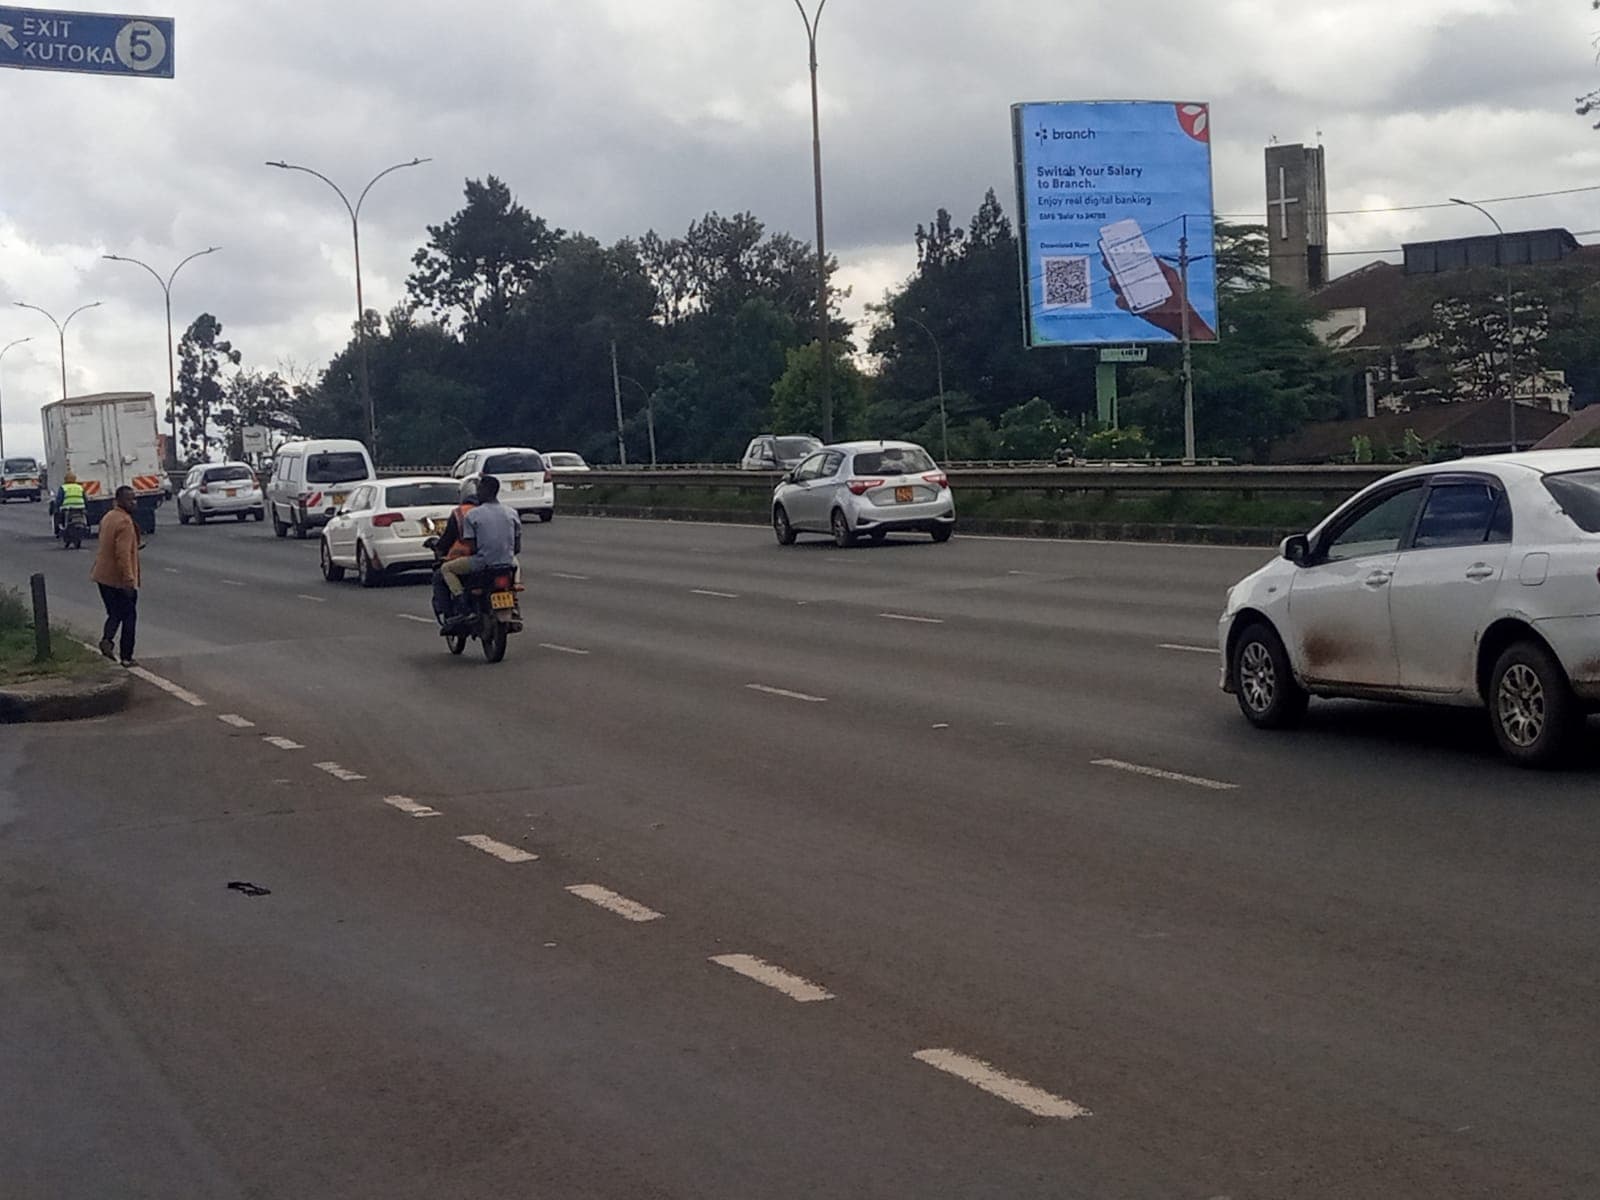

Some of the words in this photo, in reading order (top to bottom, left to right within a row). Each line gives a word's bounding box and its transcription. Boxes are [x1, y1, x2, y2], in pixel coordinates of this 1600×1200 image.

[23, 18, 72, 38] EXIT
[130, 26, 152, 62] 5
[23, 41, 116, 65] KUTOKA
[1052, 128, 1096, 141] branch
[1037, 166, 1076, 177] Switch
[1078, 165, 1104, 176] Your
[1107, 165, 1143, 178] Salary
[1038, 179, 1049, 189] to
[1052, 178, 1096, 189] Branch.
[1038, 196, 1062, 207] Enjoy
[1065, 196, 1082, 205] real
[1085, 195, 1113, 206] digital
[1115, 195, 1152, 206] banking
